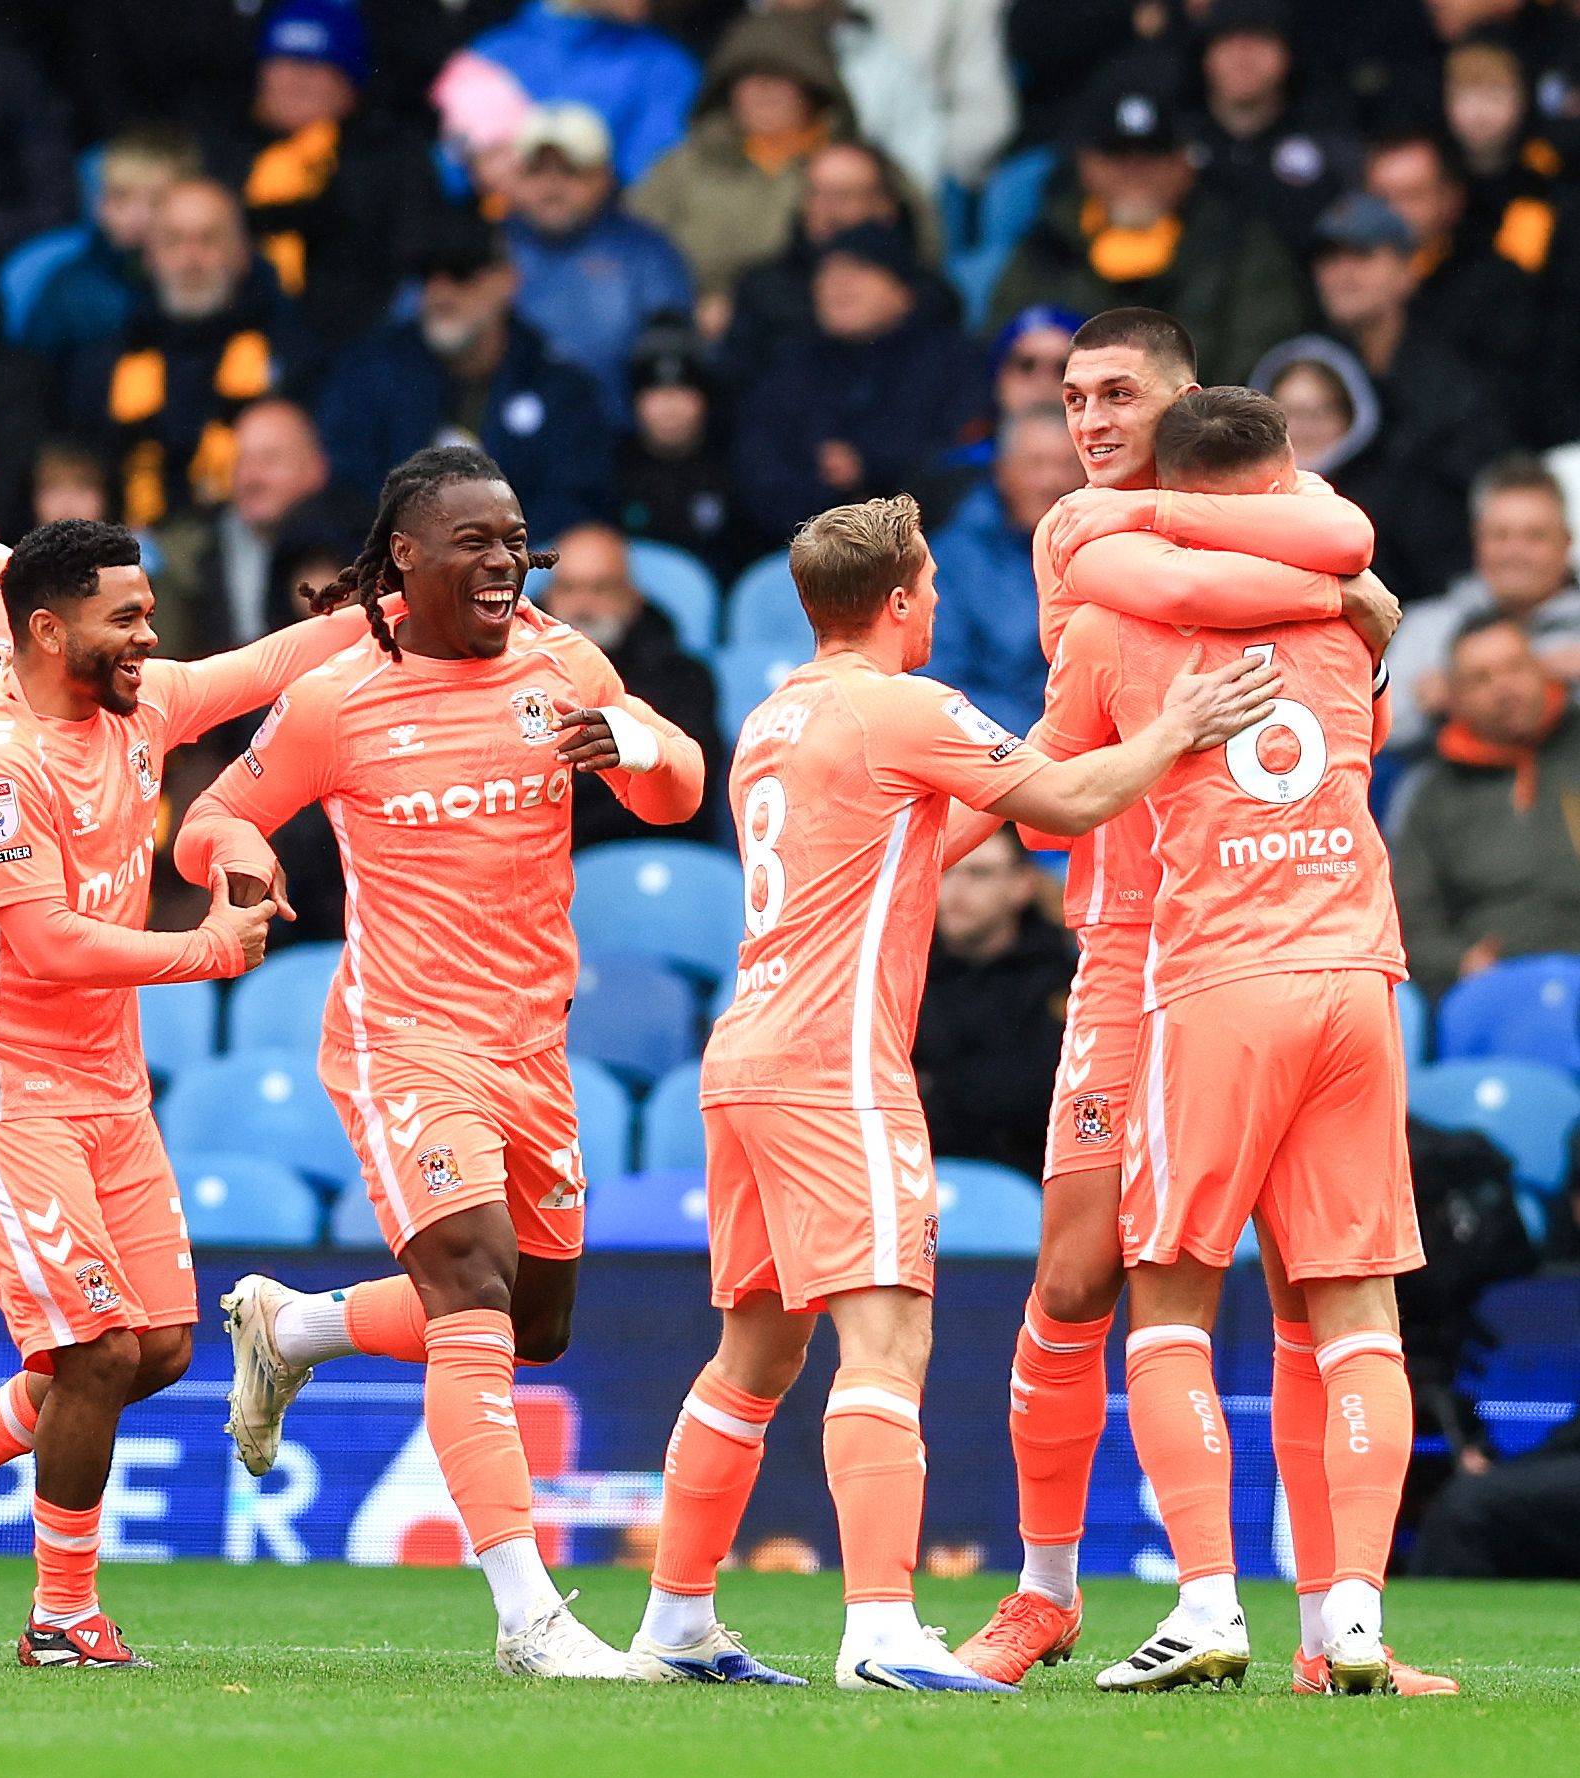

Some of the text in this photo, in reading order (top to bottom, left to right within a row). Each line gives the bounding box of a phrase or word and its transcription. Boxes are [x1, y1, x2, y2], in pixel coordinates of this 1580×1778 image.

[1226, 642, 1327, 805] 6
[383, 767, 568, 825] monzo
[744, 775, 787, 938] 8
[1219, 827, 1354, 867] monzo
[1297, 860, 1357, 876] BUSINESS
